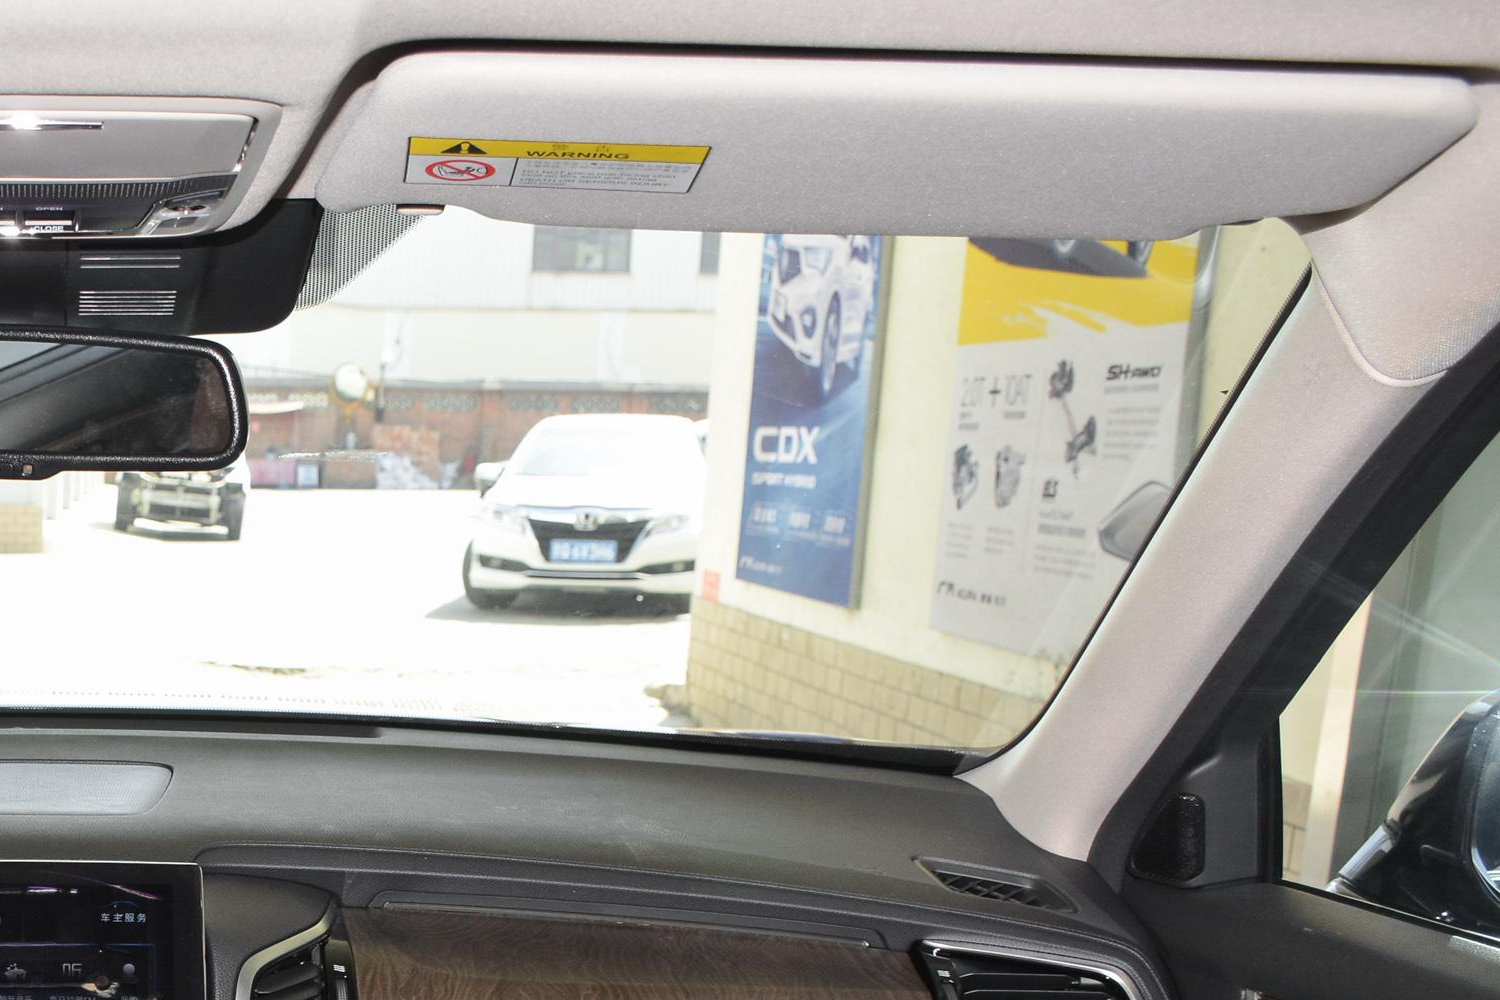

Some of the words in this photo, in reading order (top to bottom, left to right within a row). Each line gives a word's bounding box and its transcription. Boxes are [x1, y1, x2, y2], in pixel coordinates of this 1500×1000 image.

[526, 150, 630, 160] WARNING
[753, 426, 820, 464] CDX
[100, 912, 147, 923] 车主服务
